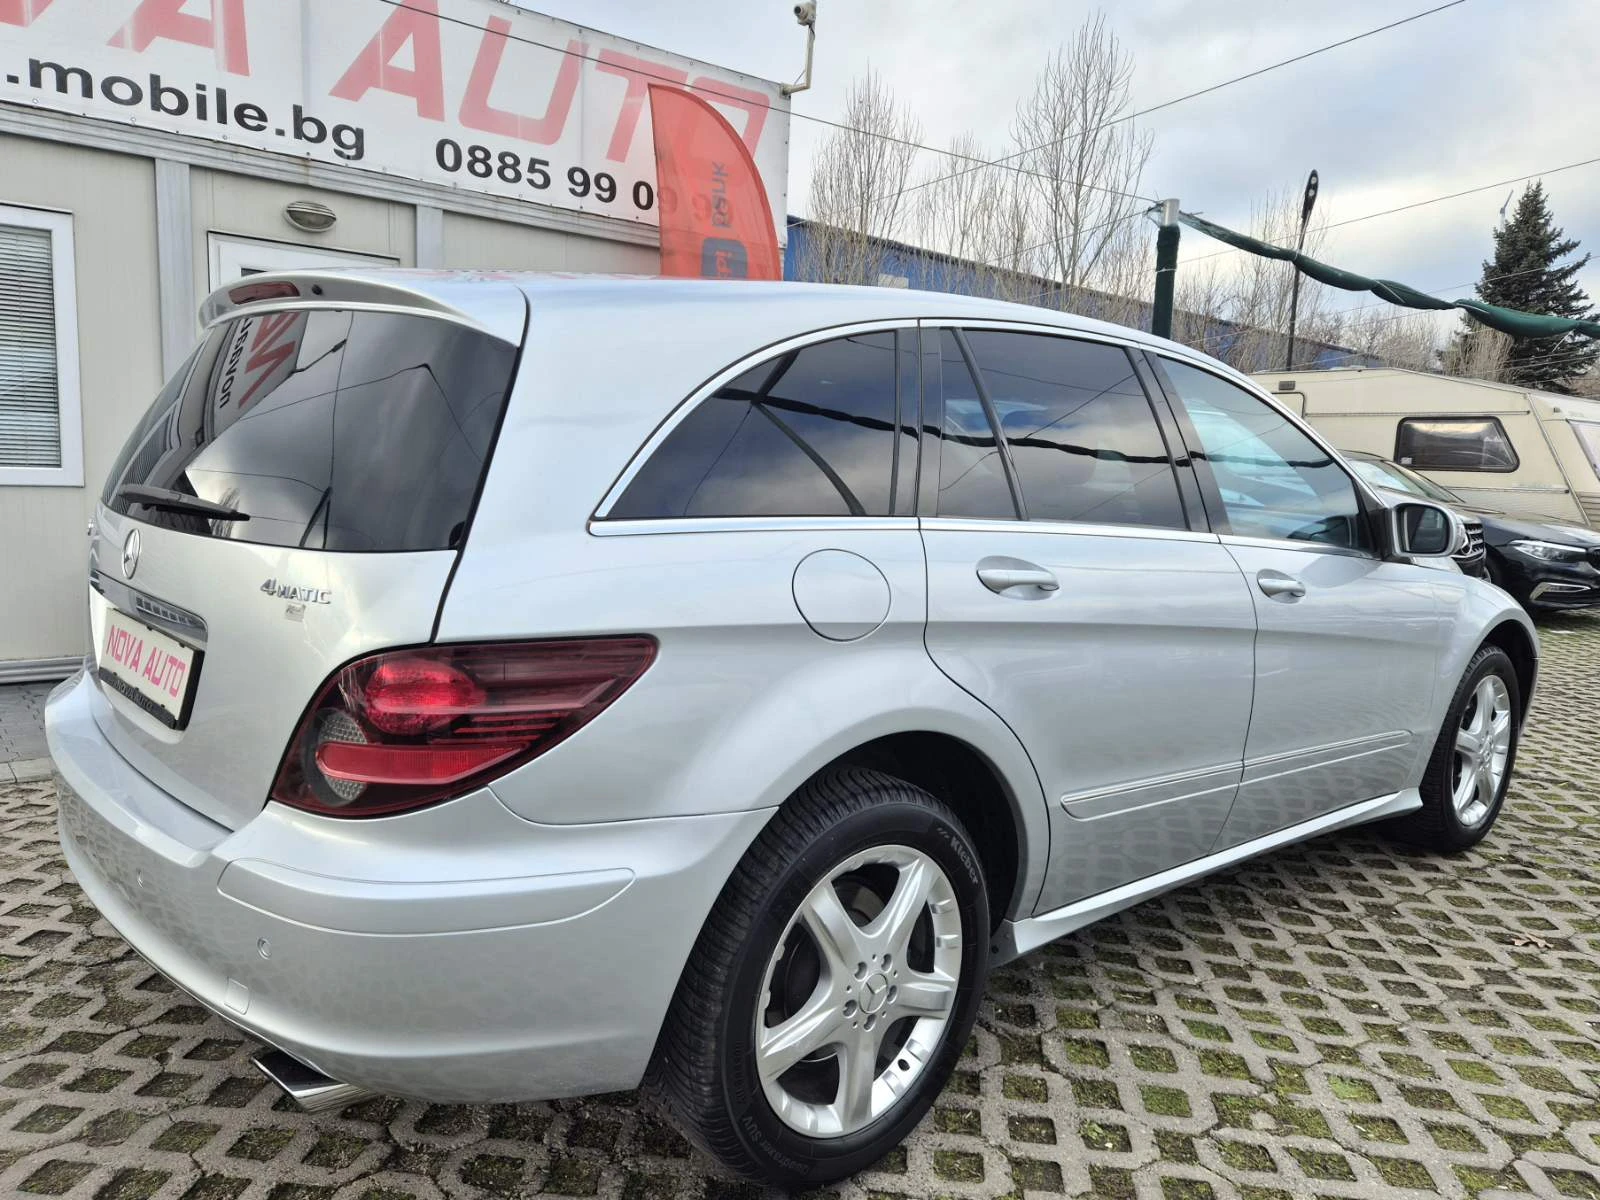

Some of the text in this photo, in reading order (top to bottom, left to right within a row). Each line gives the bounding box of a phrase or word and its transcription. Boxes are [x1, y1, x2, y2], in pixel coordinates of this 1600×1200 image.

[328, 0, 770, 170] AUTO
[435, 138, 552, 190] 0885
[567, 166, 617, 204] 99
[260, 577, 333, 605] 4MATIC
[106, 624, 188, 698] NOVA AUTO
[950, 835, 979, 885] Kleber
[742, 1115, 763, 1143] SUV
